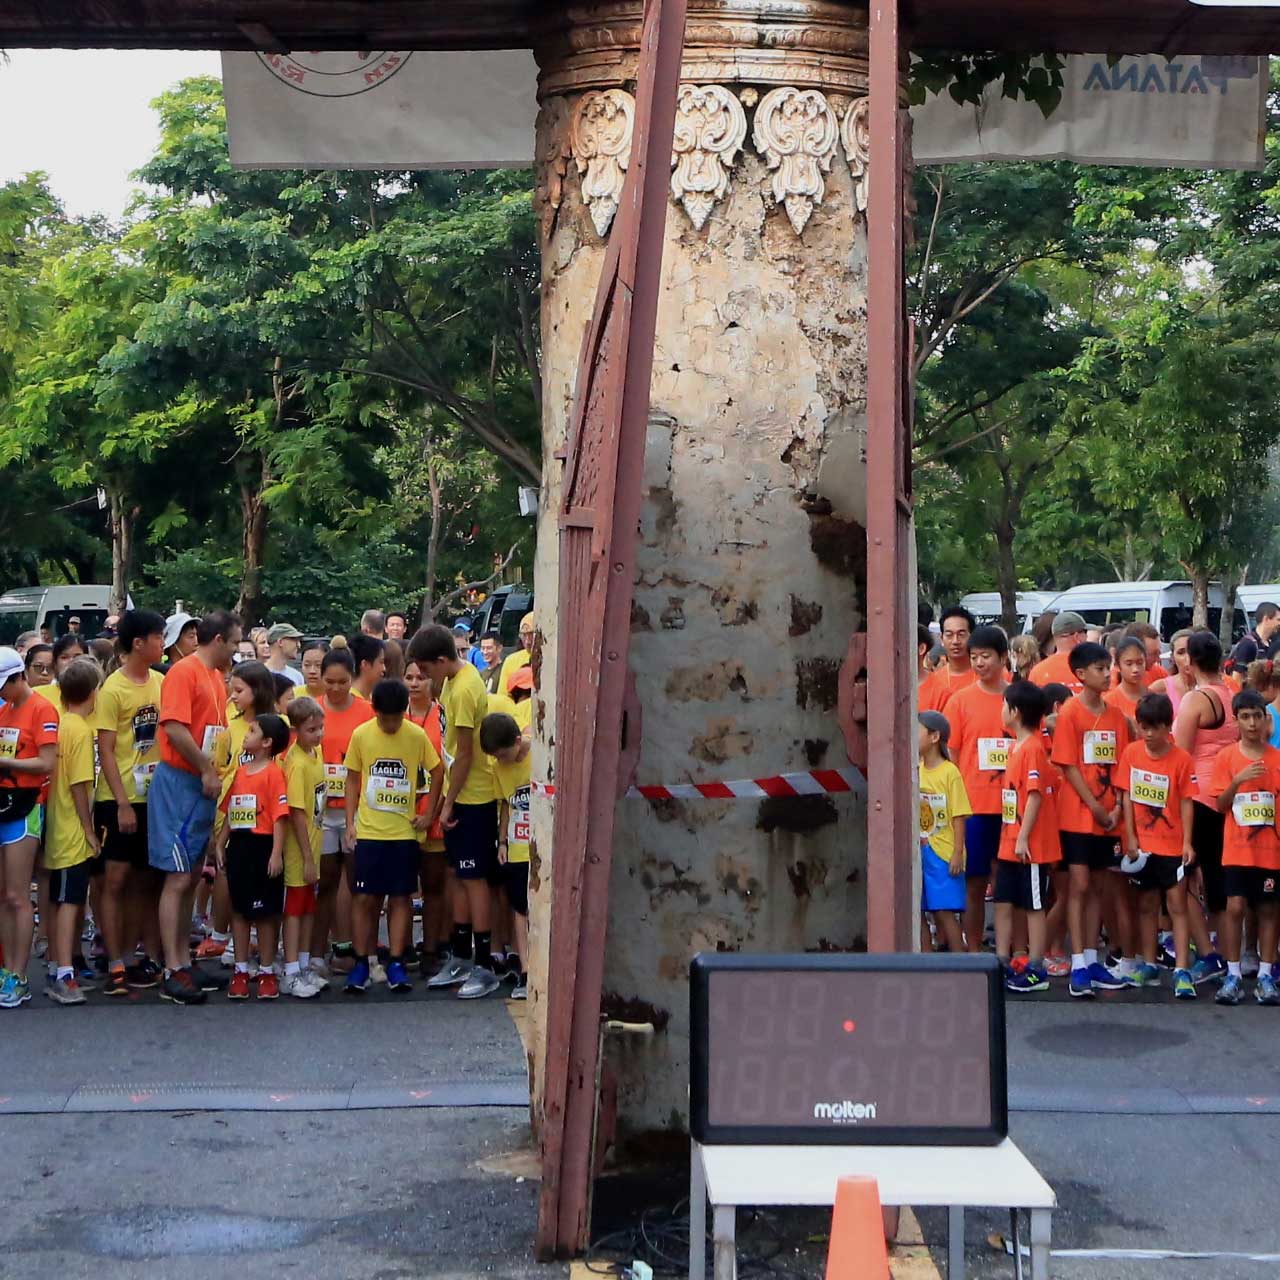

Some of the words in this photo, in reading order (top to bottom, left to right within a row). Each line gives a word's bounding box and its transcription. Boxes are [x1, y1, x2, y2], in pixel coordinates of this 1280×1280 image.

[372, 766, 404, 775] EAGLES
[376, 792, 408, 805] 3066
[1134, 785, 1165, 801] 3038
[459, 859, 476, 869] ICS
[814, 1100, 876, 1119] molten
